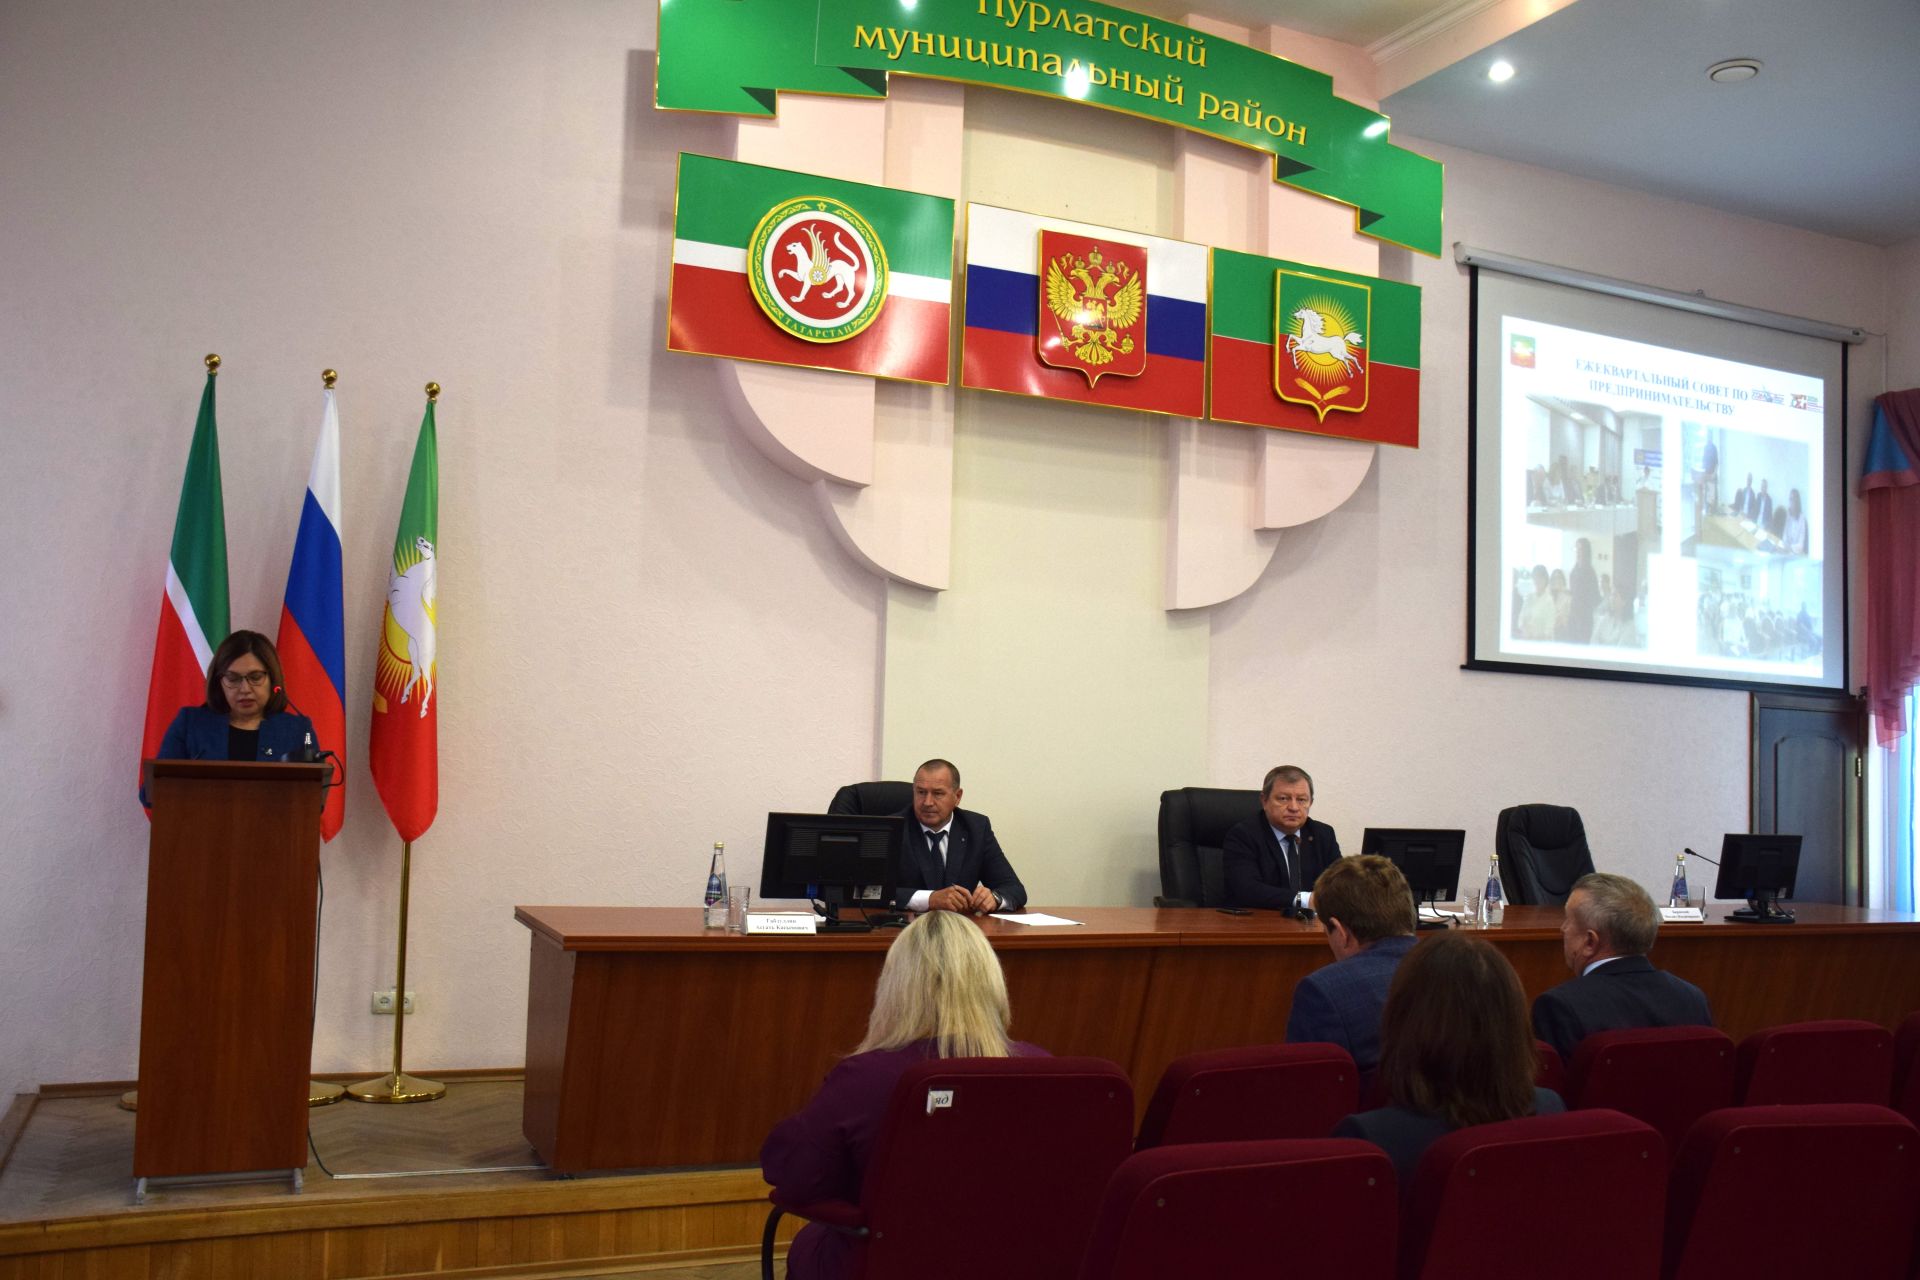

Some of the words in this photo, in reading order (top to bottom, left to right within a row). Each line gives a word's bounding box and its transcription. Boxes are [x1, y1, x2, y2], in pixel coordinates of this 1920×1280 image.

[1197, 92, 1308, 146] район
[785, 317, 852, 338] ТАТАРСТАН
[1575, 358, 1690, 390] ЕЖЕКВАРТАЛЬНЫЙ
[1692, 378, 1731, 399] СОВЕТ
[1732, 388, 1749, 401] ПО
[1589, 379, 1736, 416] ПРЕДПРИНИМАТЕЛЬСТВУ
